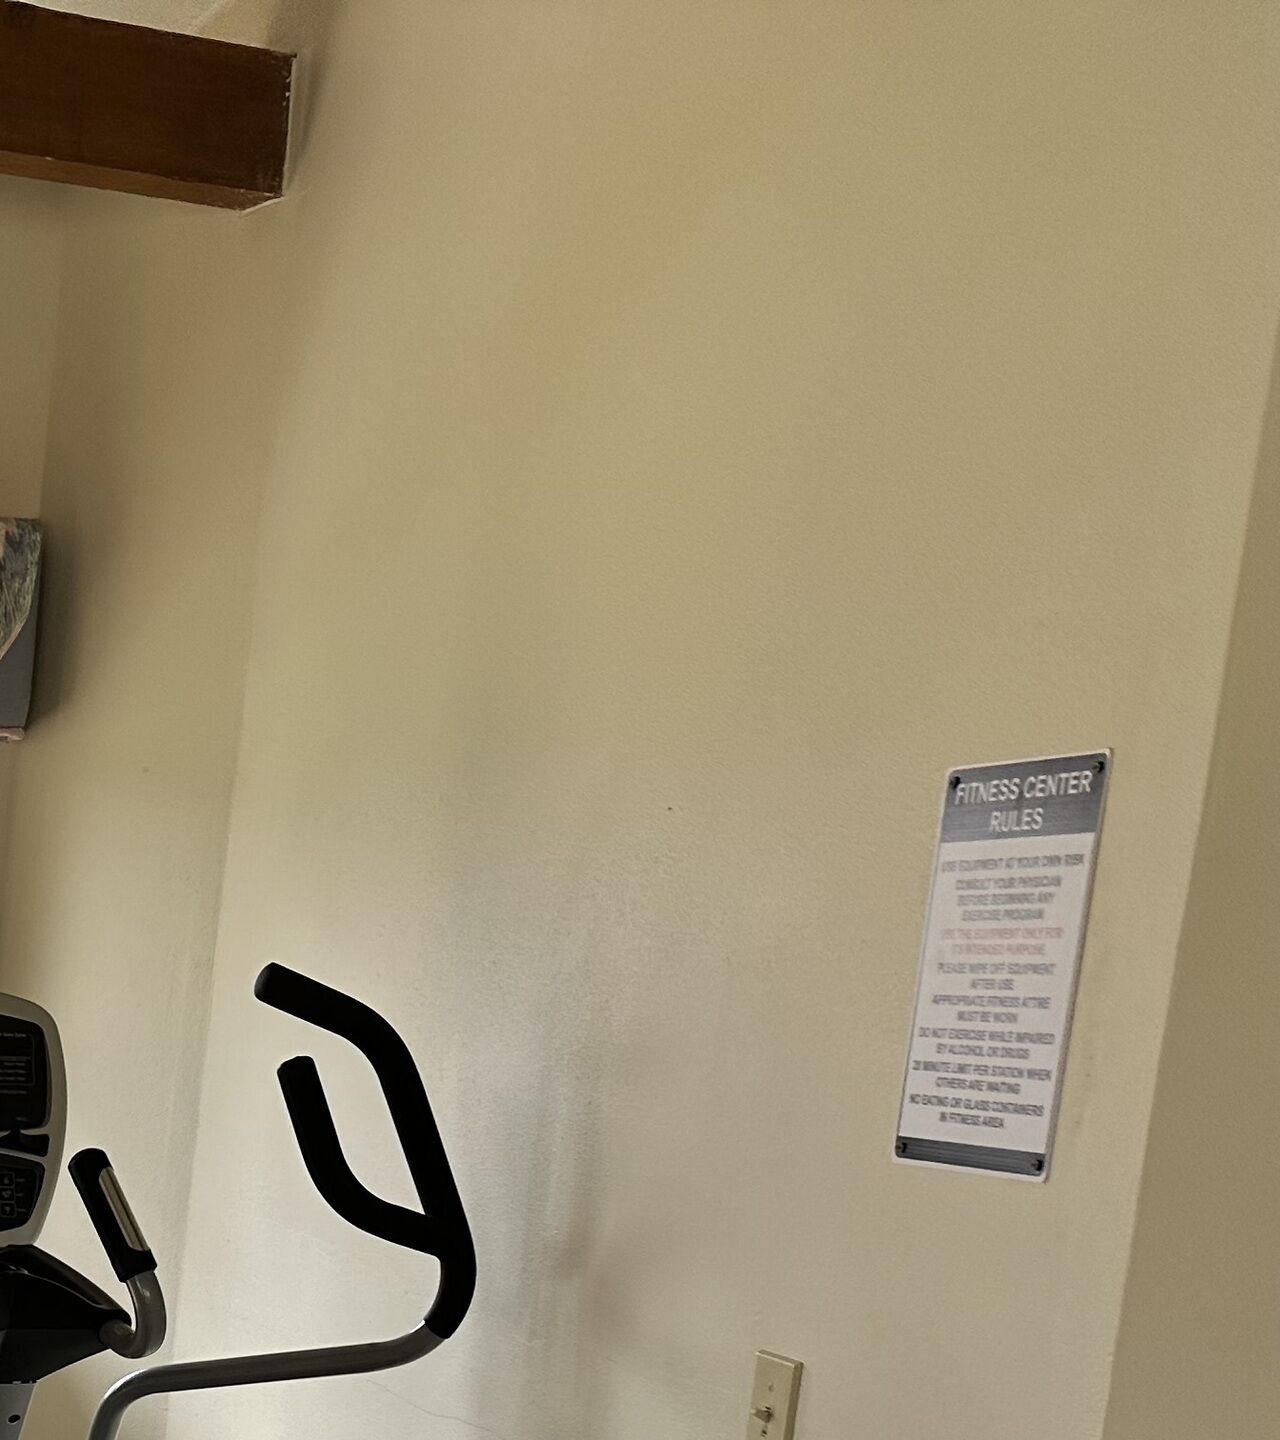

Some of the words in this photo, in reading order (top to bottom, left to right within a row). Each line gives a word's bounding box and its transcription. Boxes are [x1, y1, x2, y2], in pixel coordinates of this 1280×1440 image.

[955, 777, 1020, 805] FITNESS
[1023, 770, 1093, 798] CENTER
[990, 807, 1044, 833] RULES
[937, 962, 967, 974] PLEASE
[1007, 963, 1056, 975] EQUIPMENT
[970, 978, 996, 990] AFTER
[948, 1028, 987, 1041] EXERCISE
[948, 1044, 985, 1057] ALCOHOL
[1000, 1047, 1031, 1059] DRUGS
[991, 1065, 1025, 1078] STATION
[922, 1094, 949, 1107] EATING
[963, 1098, 991, 1111] GLASS
[992, 1101, 1045, 1116] CONTAINERS
[948, 1112, 982, 1126] FITNESS
[982, 1116, 1005, 1128] AREA
